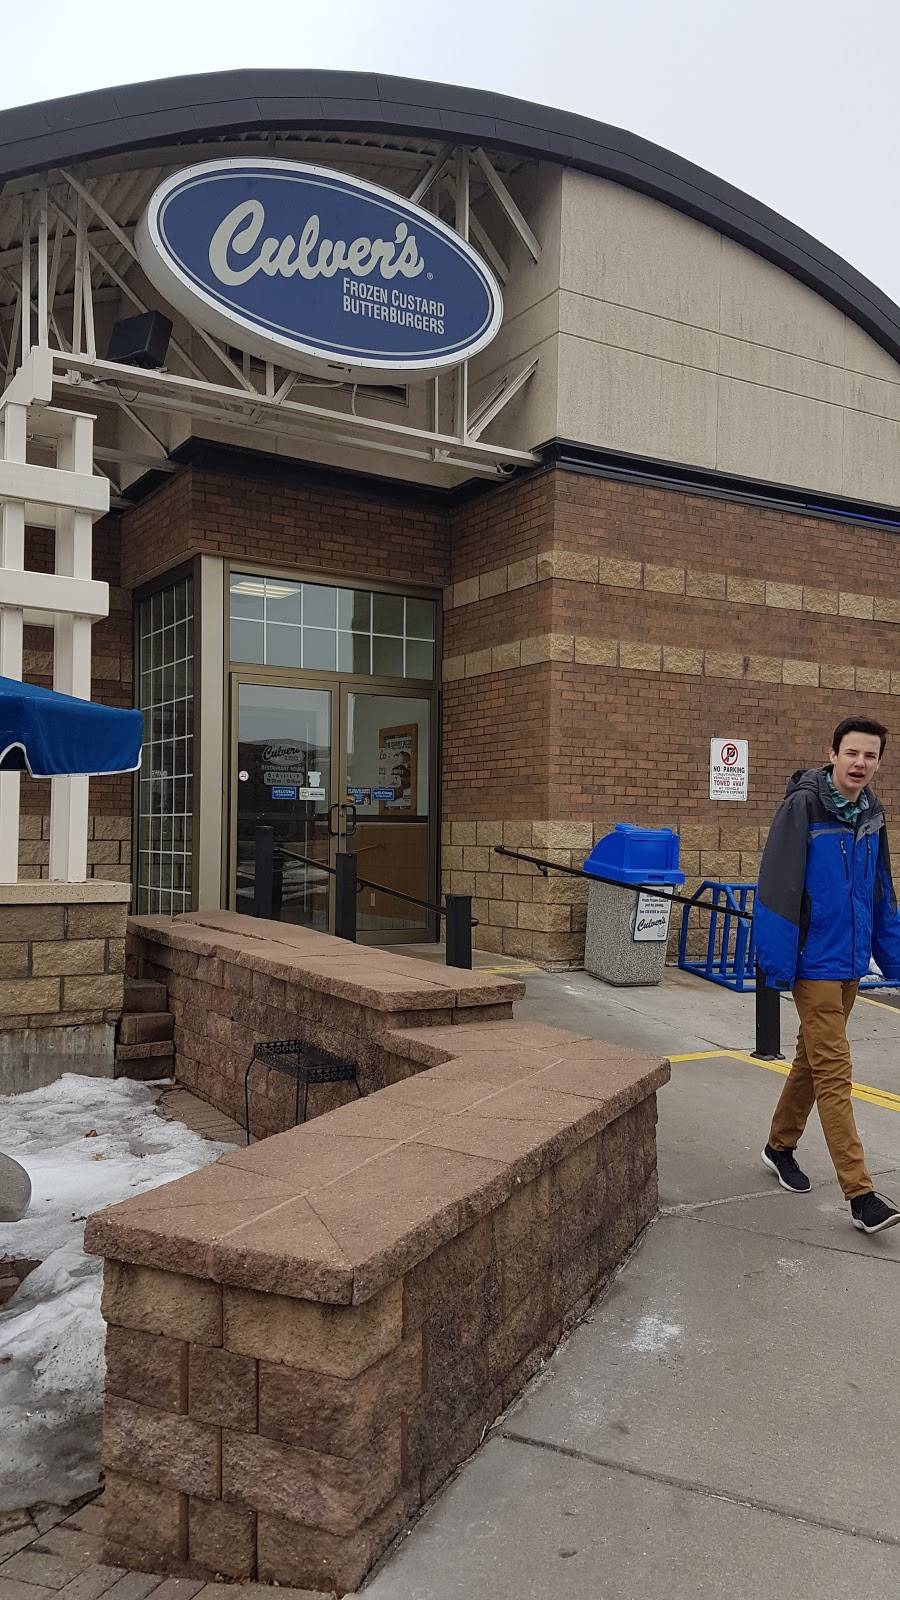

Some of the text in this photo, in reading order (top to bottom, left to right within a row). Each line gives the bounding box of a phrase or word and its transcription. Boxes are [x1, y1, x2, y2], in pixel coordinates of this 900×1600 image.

[208, 199, 425, 287] Culver's
[343, 277, 445, 318] FROZEN CUSTARD
[343, 295, 445, 336] BUTTERBURGERS
[723, 766, 745, 774] PARKING
[637, 916, 666, 932] Culver's
